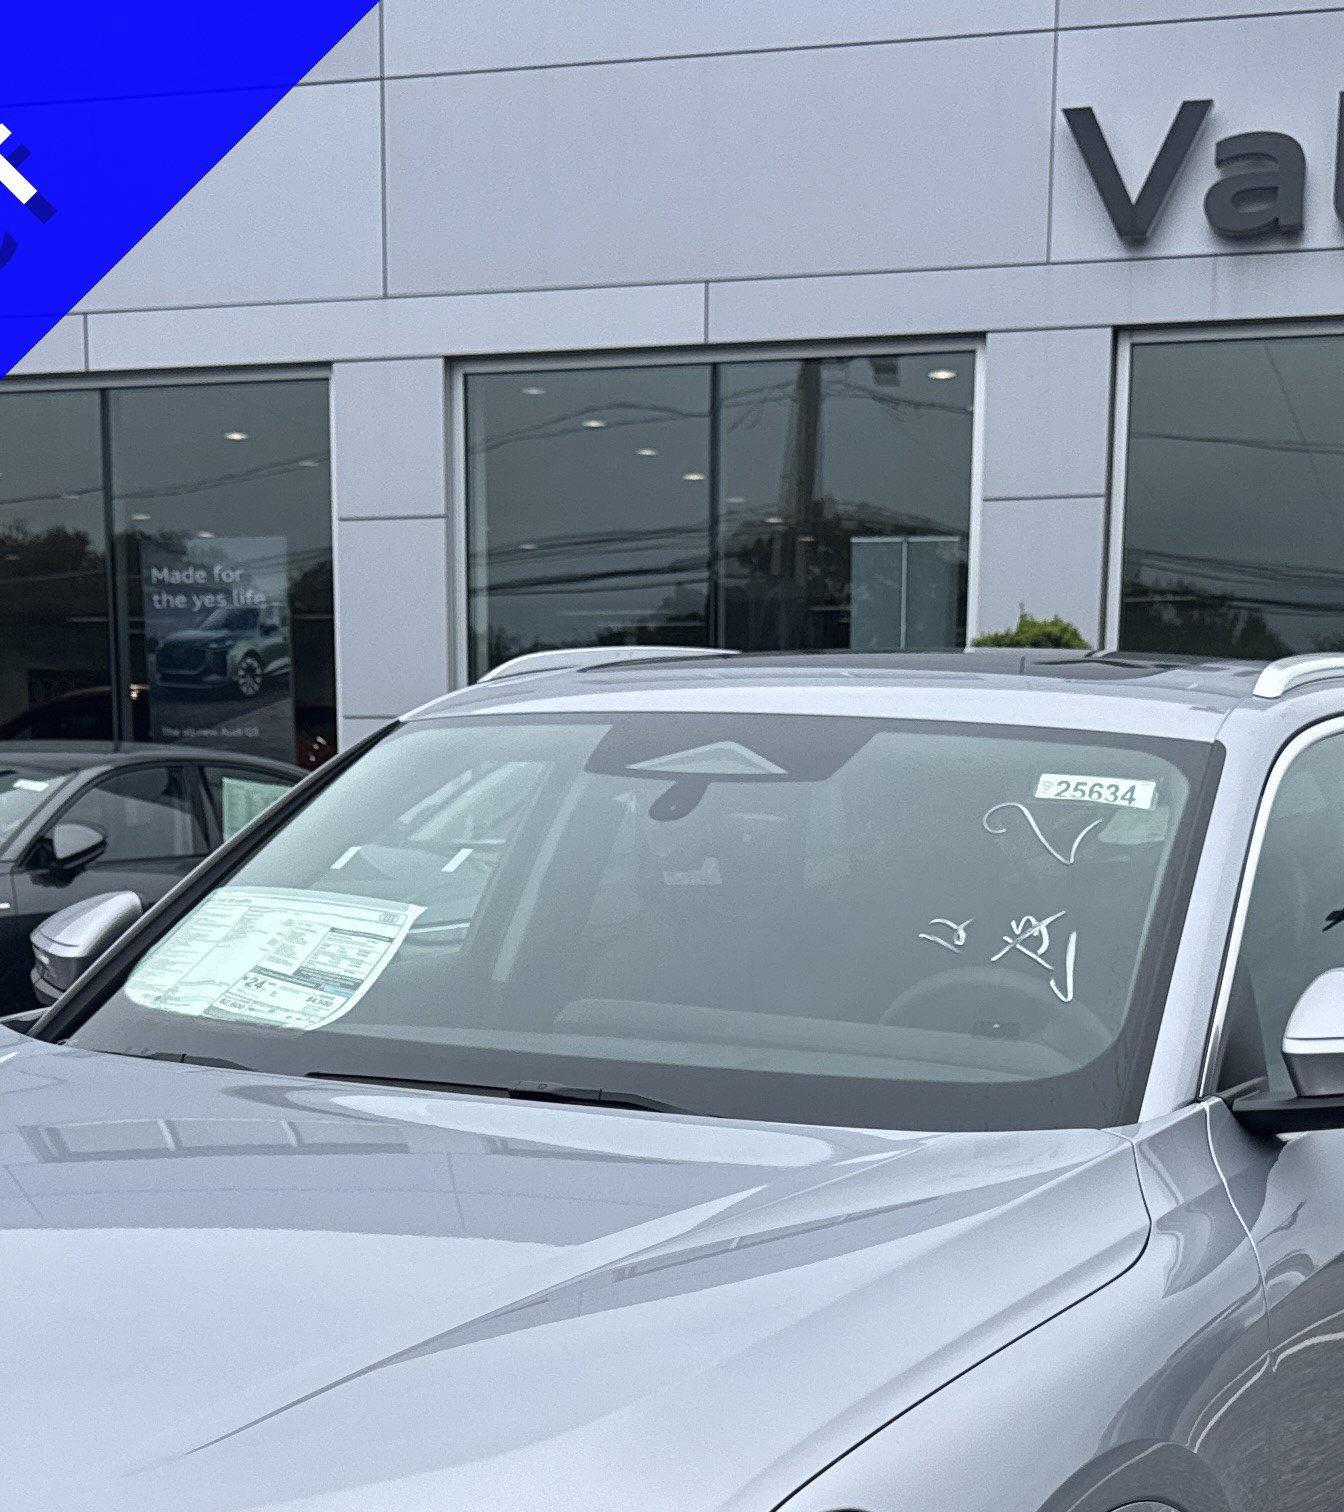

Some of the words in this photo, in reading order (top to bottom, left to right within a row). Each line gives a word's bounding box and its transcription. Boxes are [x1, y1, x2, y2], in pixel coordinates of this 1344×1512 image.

[151, 566, 207, 584] Made
[213, 564, 244, 583] for
[152, 591, 187, 609] the
[192, 592, 227, 612] yes
[1054, 780, 1137, 806] 25634
